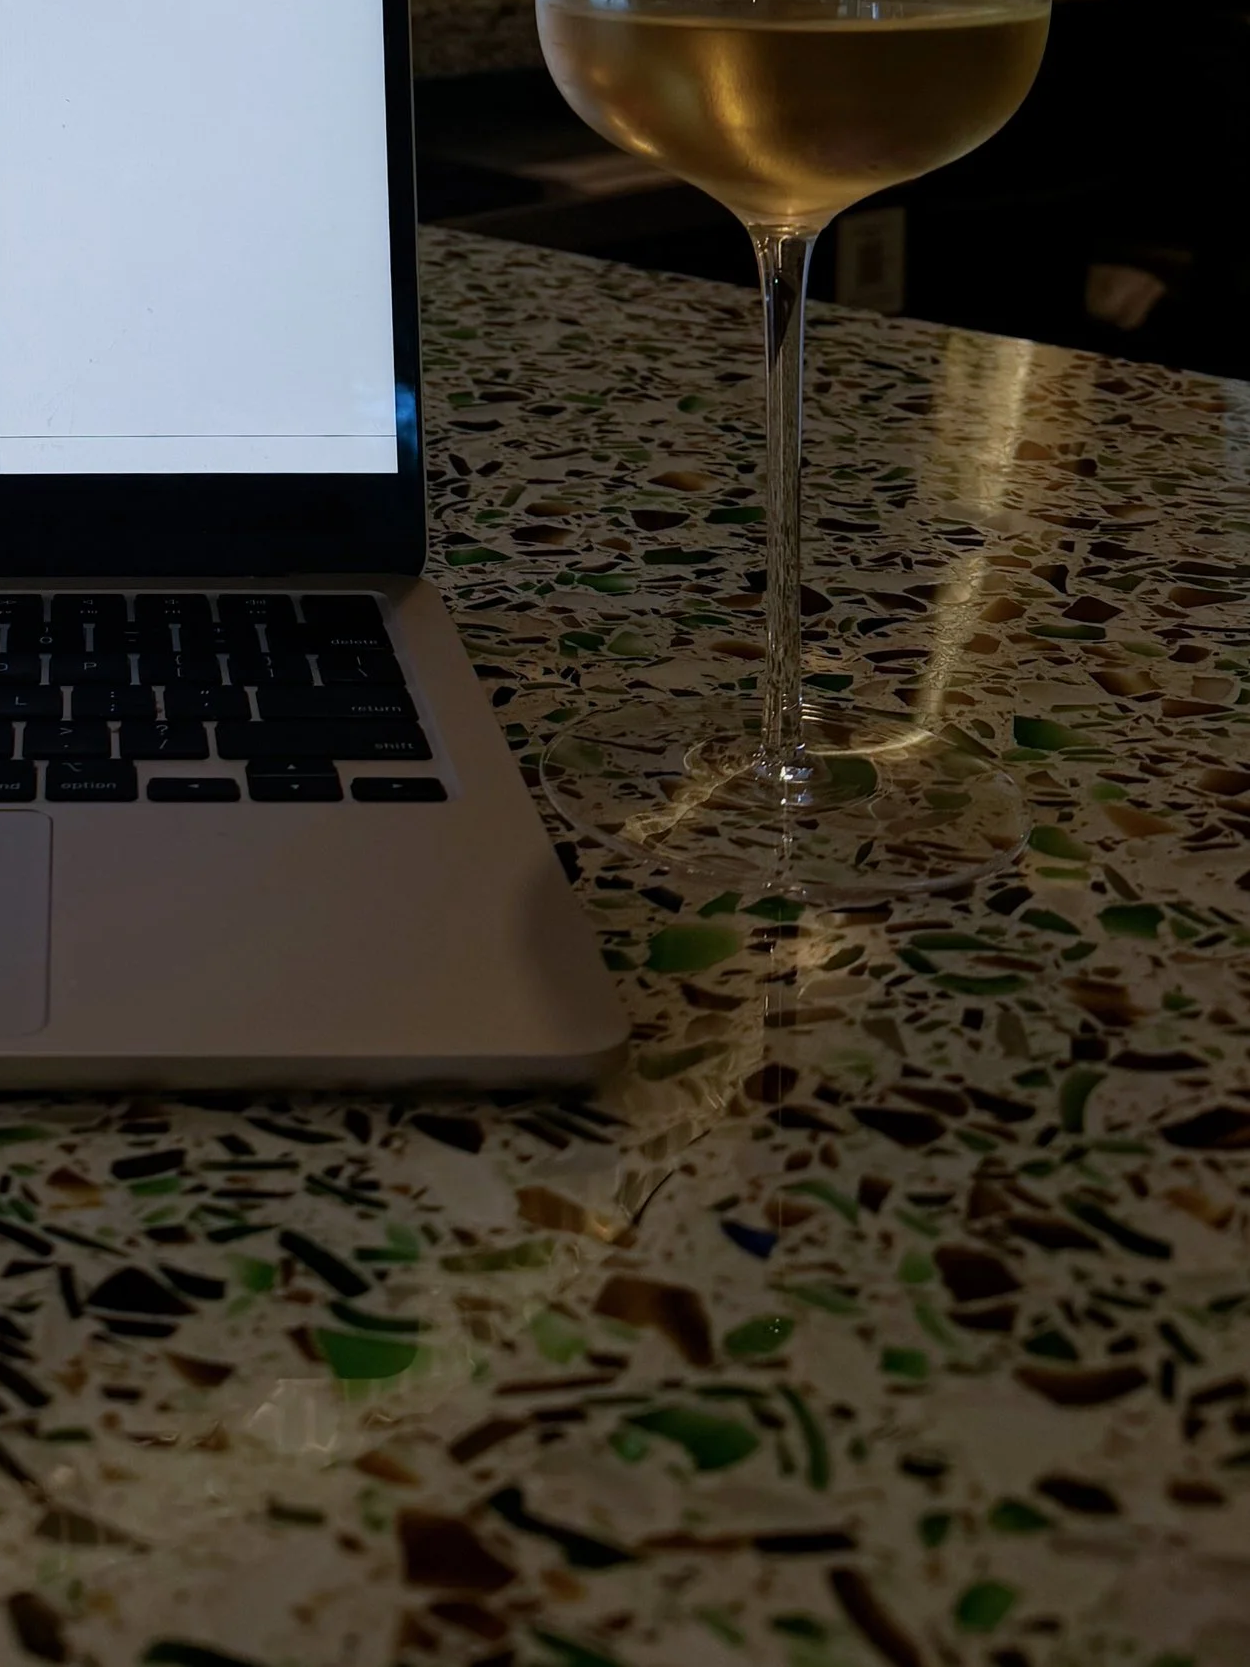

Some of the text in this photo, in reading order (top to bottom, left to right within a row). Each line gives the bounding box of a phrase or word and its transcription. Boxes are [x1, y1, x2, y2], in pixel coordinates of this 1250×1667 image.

[83, 662, 97, 670] P
[15, 696, 26, 706] L
[60, 781, 117, 790] option
